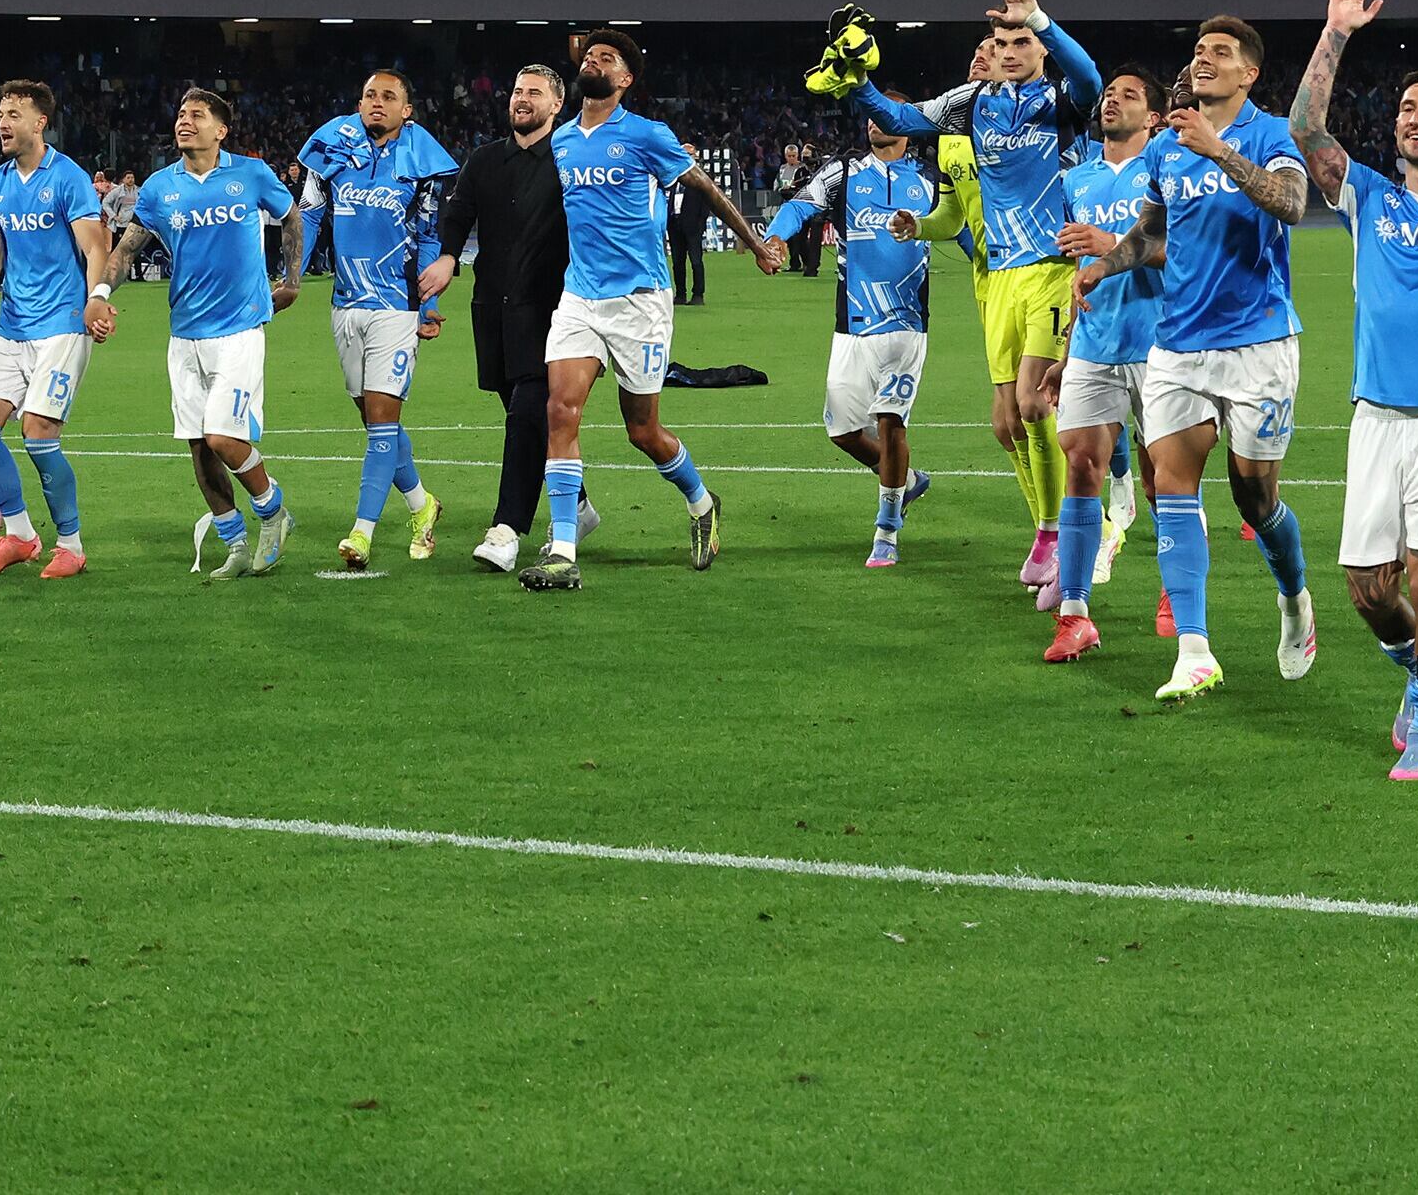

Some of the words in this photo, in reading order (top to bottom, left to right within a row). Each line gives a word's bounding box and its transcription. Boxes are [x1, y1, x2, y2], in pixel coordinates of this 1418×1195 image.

[980, 108, 999, 118] EA7
[949, 142, 962, 150] EA7
[982, 123, 1042, 151] Coca-Cola
[1164, 153, 1182, 163] EA7
[572, 167, 625, 186] MSC
[1180, 170, 1240, 201] MSC
[164, 193, 181, 203] EA7
[338, 181, 403, 210] Coca-Cola
[855, 185, 873, 195] EA7
[1073, 185, 1090, 199] EA7
[1094, 197, 1144, 226] MSC
[1384, 193, 1402, 210] EA7
[9, 212, 55, 232] MSC
[190, 204, 247, 228] MSC
[1000, 248, 1011, 259] 12
[346, 290, 352, 298] 9
[392, 350, 408, 376] 9
[642, 343, 664, 374] 15
[47, 370, 71, 401] 13
[879, 373, 915, 400] 26
[232, 388, 251, 419] 17
[1257, 397, 1292, 438] 22
